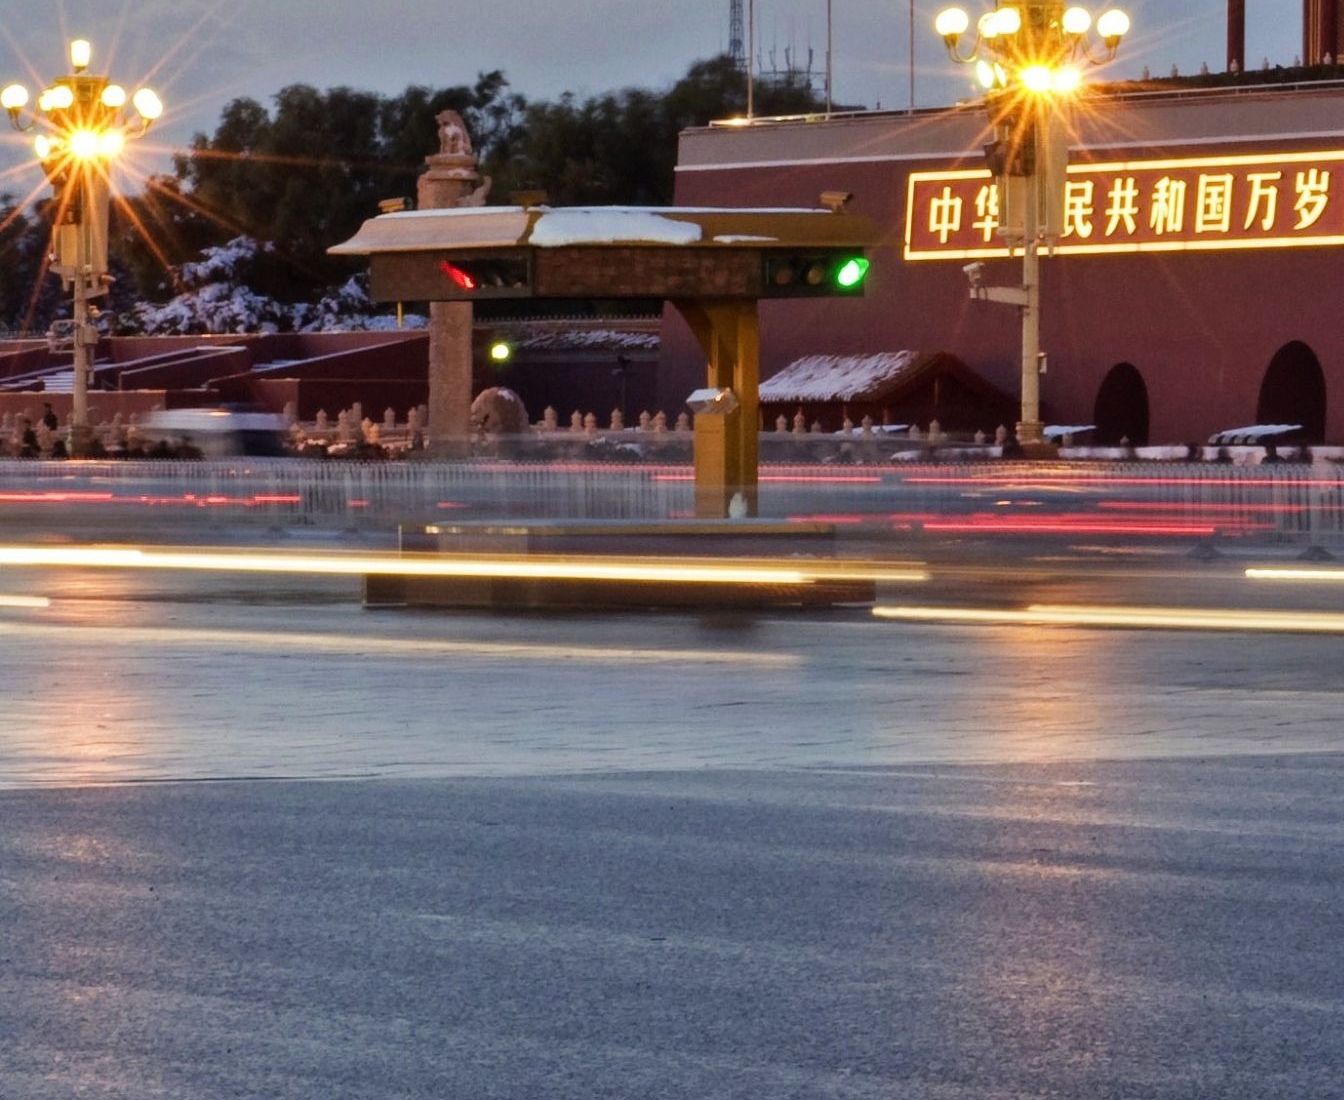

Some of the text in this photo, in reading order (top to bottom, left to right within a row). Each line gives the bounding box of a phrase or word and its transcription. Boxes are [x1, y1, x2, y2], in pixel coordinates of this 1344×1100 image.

[928, 168, 1330, 244] 中华民共和国万岁
